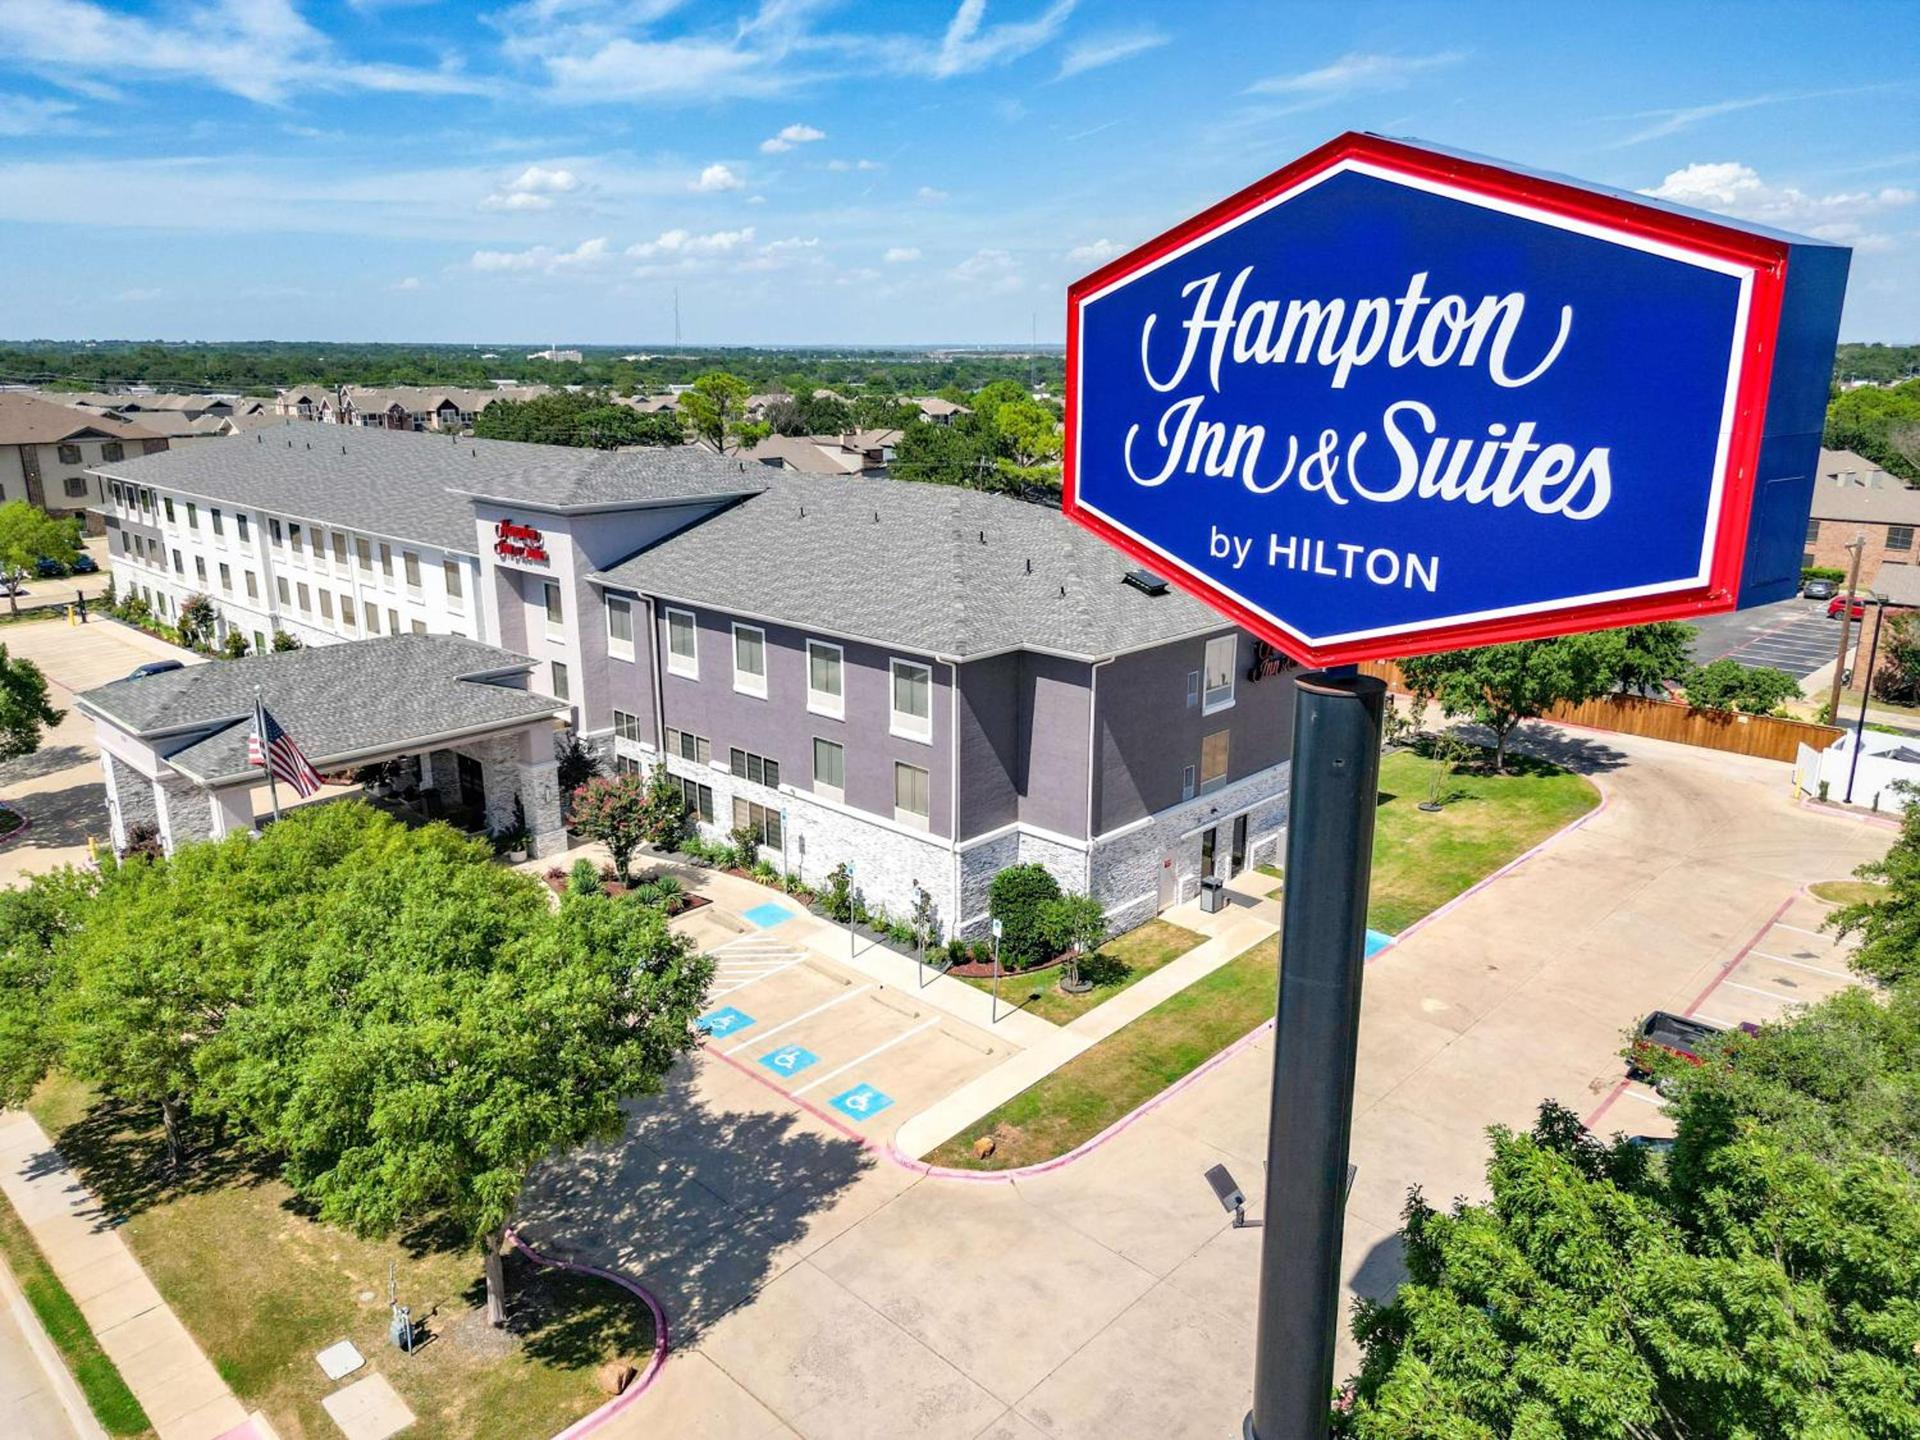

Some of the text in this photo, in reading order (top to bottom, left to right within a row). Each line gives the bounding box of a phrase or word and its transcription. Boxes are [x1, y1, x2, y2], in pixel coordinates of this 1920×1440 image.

[1141, 265, 1573, 393] Hampton
[1124, 395, 1612, 521] Inn & Suites
[1210, 525, 1440, 593] by HILTON
